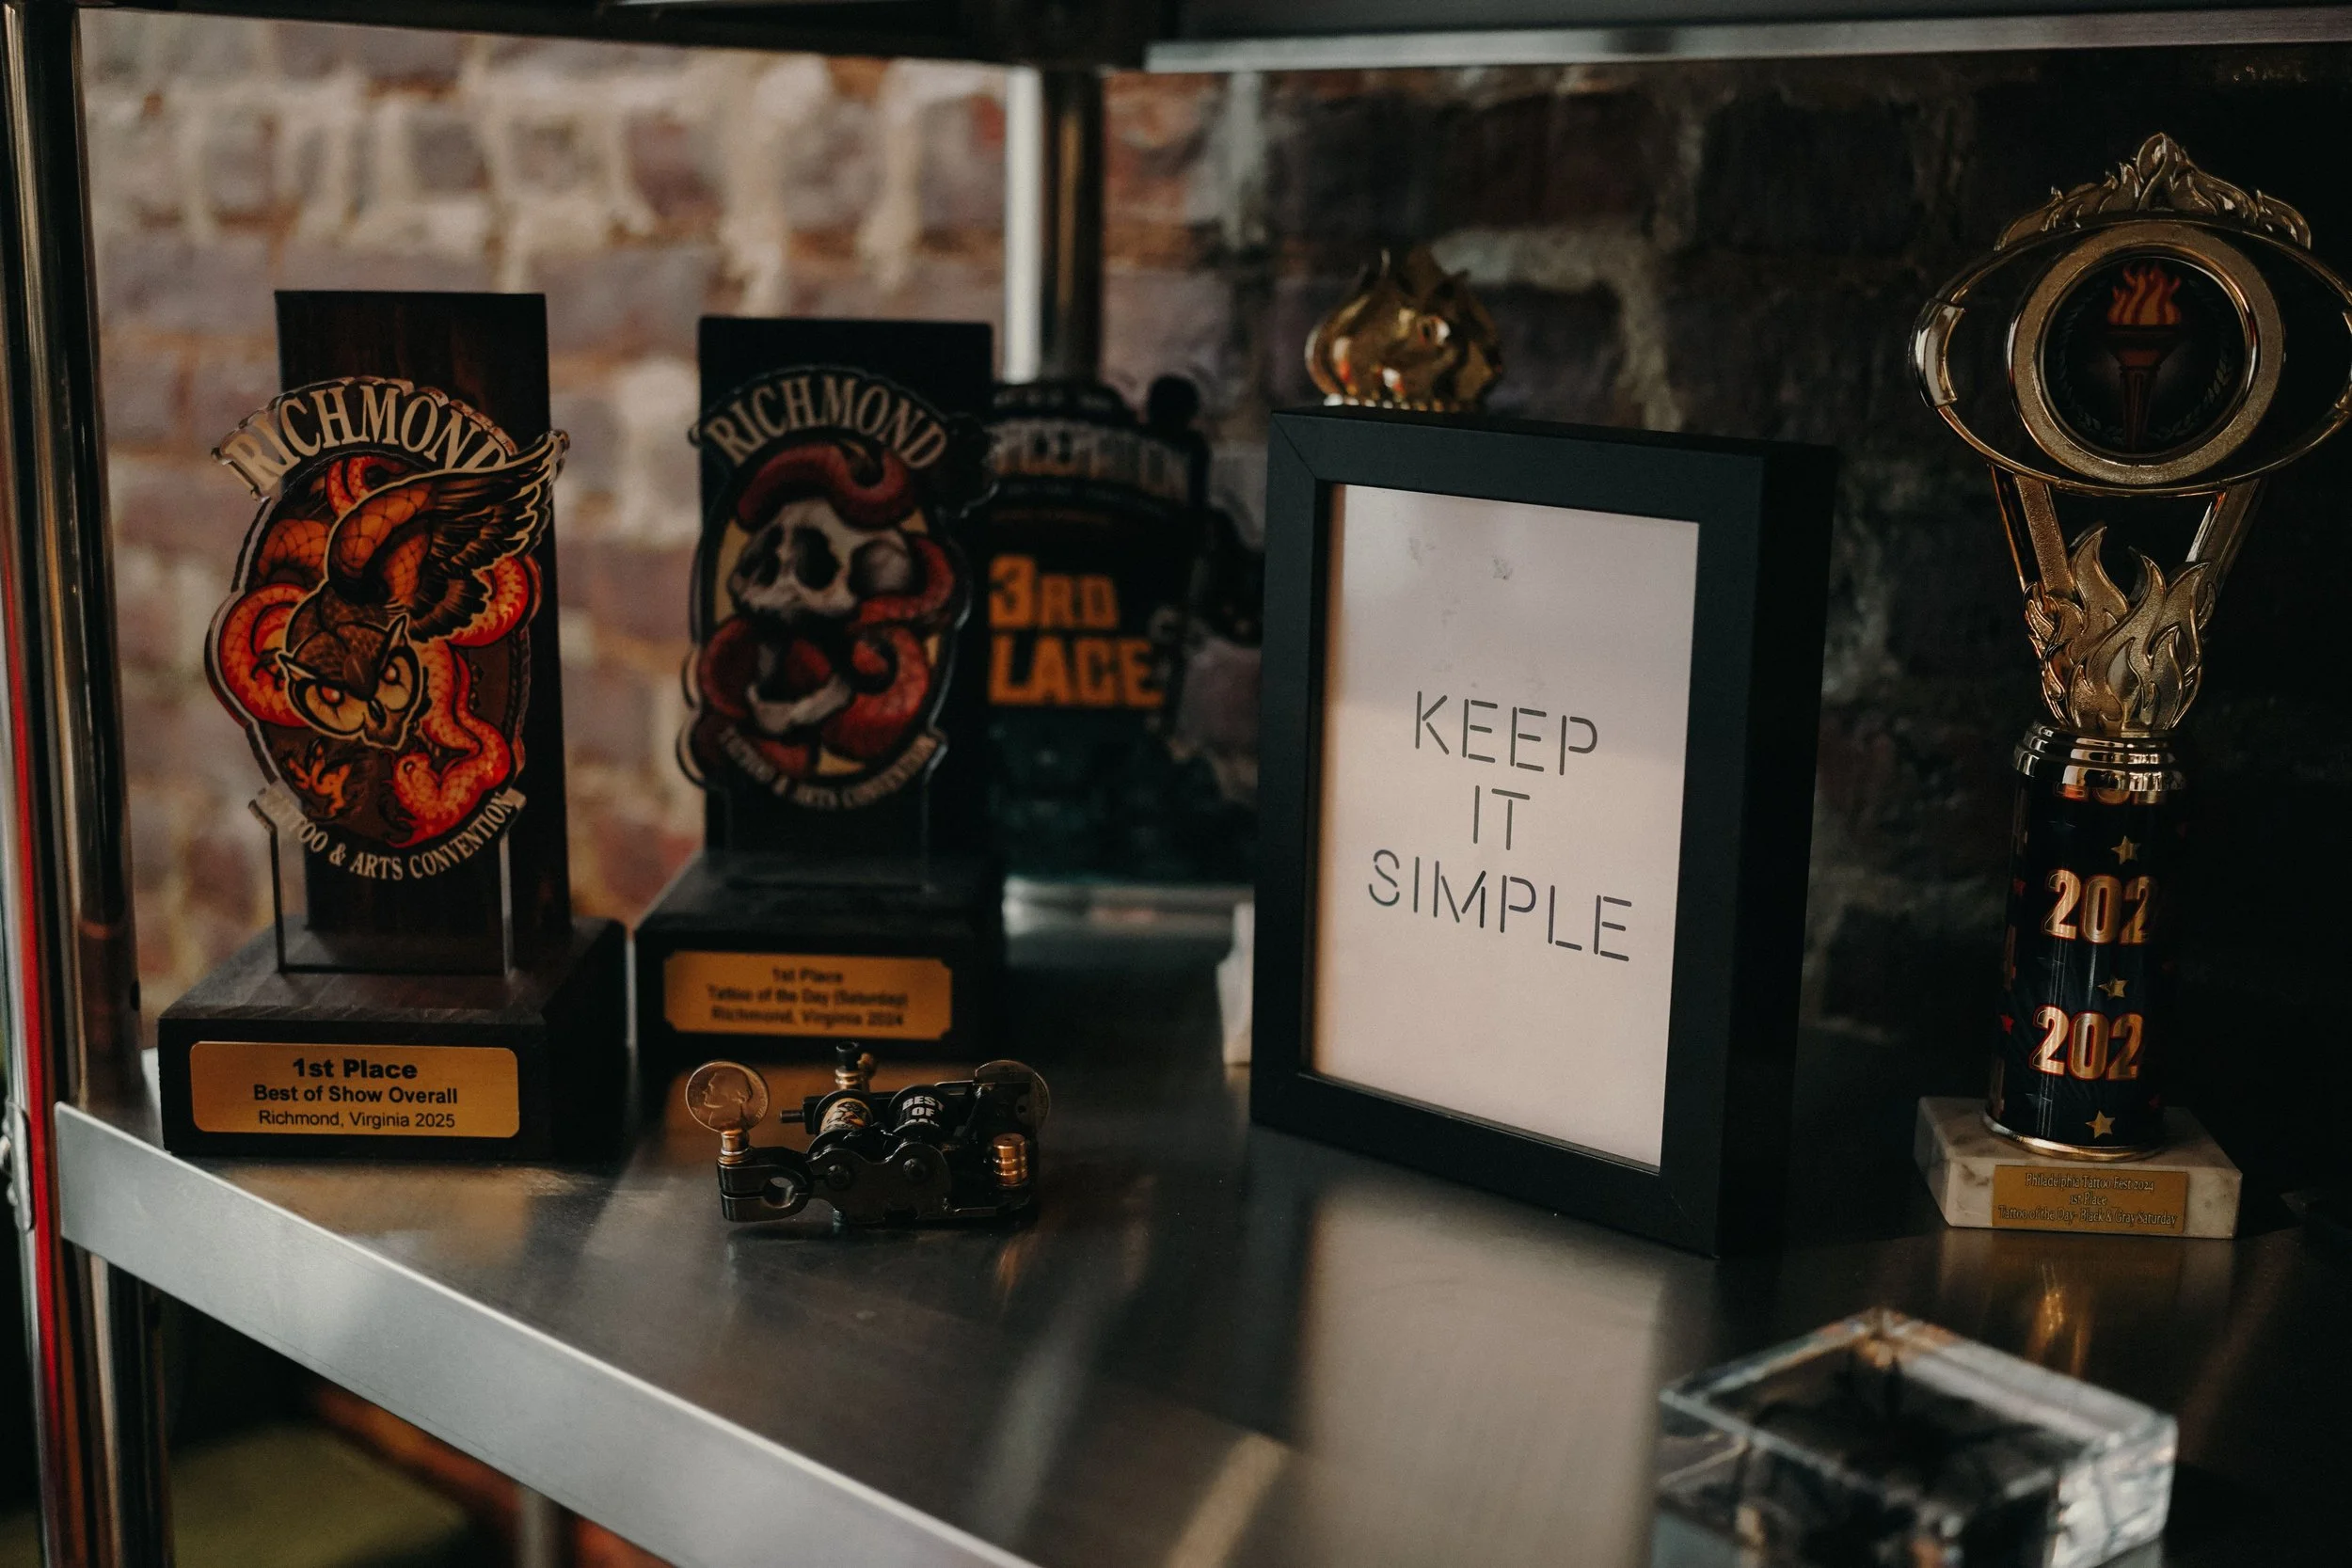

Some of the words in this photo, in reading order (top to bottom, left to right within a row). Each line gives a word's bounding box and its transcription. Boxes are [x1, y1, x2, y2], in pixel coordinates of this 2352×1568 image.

[704, 375, 947, 470] RICHMOND
[226, 384, 508, 492] RICHMOND
[988, 553, 1120, 630] 3RD
[988, 635, 1167, 710] LACE
[1415, 690, 1598, 776] KEEP
[1472, 784, 1531, 851] IT
[328, 843, 346, 866] &
[349, 851, 404, 881] ARTS
[408, 792, 518, 879] CONVENTION
[1368, 848, 1632, 962] SIMPLE
[2041, 866, 2158, 945] 202
[771, 968, 796, 983] 1st
[799, 969, 844, 985] Place
[757, 988, 771, 1002] of
[776, 988, 797, 1003] the
[801, 989, 829, 1006] Day
[802, 1010, 863, 1029] Virginia
[2028, 1004, 2145, 1082] 202
[293, 1058, 334, 1079] 1st
[342, 1059, 419, 1080] Place
[253, 1085, 299, 1102] Best
[303, 1086, 324, 1102] of
[328, 1086, 383, 1103] Show
[389, 1087, 458, 1104] Overall
[902, 1095, 945, 1112] BEST
[258, 1110, 345, 1128] Richmond,
[349, 1112, 411, 1131] Virginia
[415, 1113, 456, 1128] 2025
[911, 1106, 935, 1117] OF
[2025, 1172, 2080, 1192] Philadelphia
[2082, 1174, 2111, 1189] Tattoo
[2113, 1176, 2132, 1190] Fest
[2133, 1179, 2155, 1193] 2024
[2083, 1192, 2107, 1206] Place
[1998, 1205, 2026, 1220] Tattoo
[2027, 1206, 2040, 1220] of
[2040, 1206, 2055, 1221] the
[2080, 1207, 2104, 1223] Black
[2106, 1210, 2113, 1223] &
[2115, 1209, 2135, 1227] Gray
[2137, 1210, 2178, 1229] Saturday
